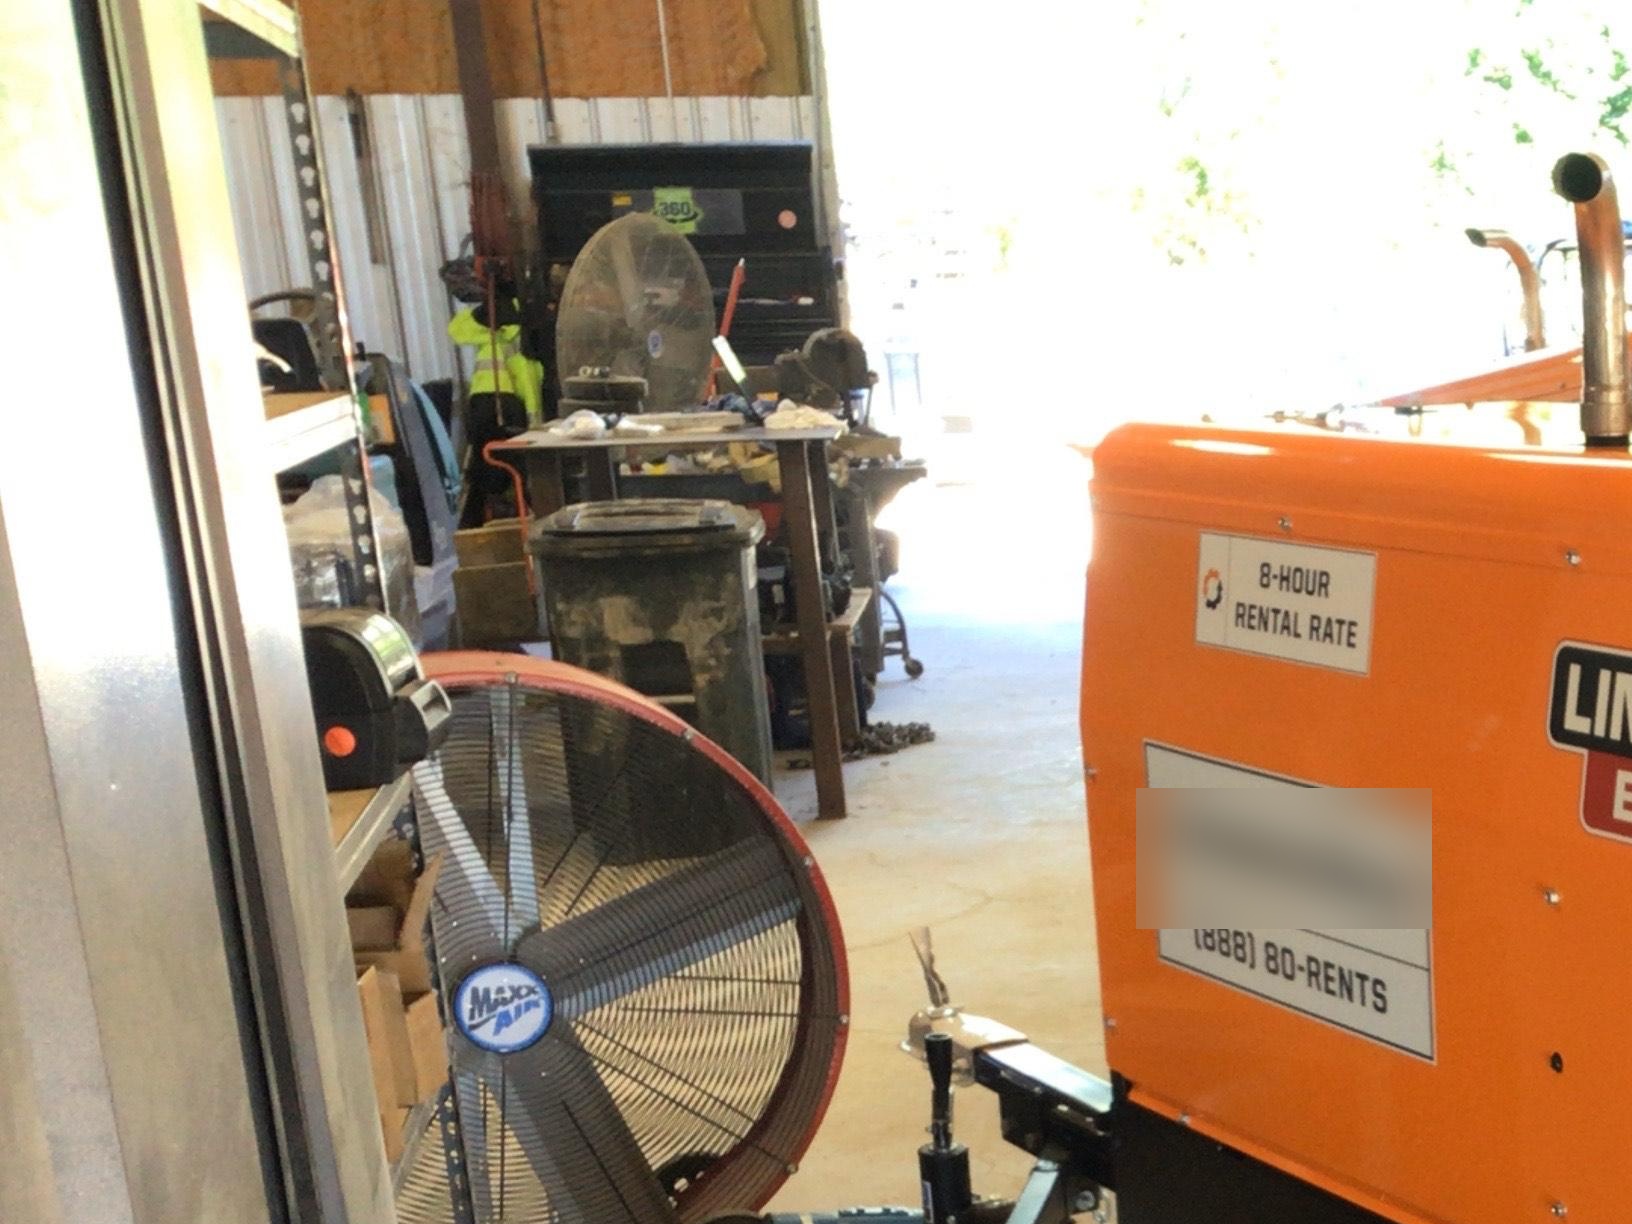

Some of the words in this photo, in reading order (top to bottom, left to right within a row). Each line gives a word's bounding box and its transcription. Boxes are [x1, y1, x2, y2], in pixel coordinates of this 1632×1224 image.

[1259, 562, 1331, 598] 8-HOUR
[1235, 601, 1302, 639] RENTAL
[1309, 614, 1359, 649] RATE
[1264, 941, 1389, 1014] 80-RENTS
[468, 984, 539, 1021] MAXX
